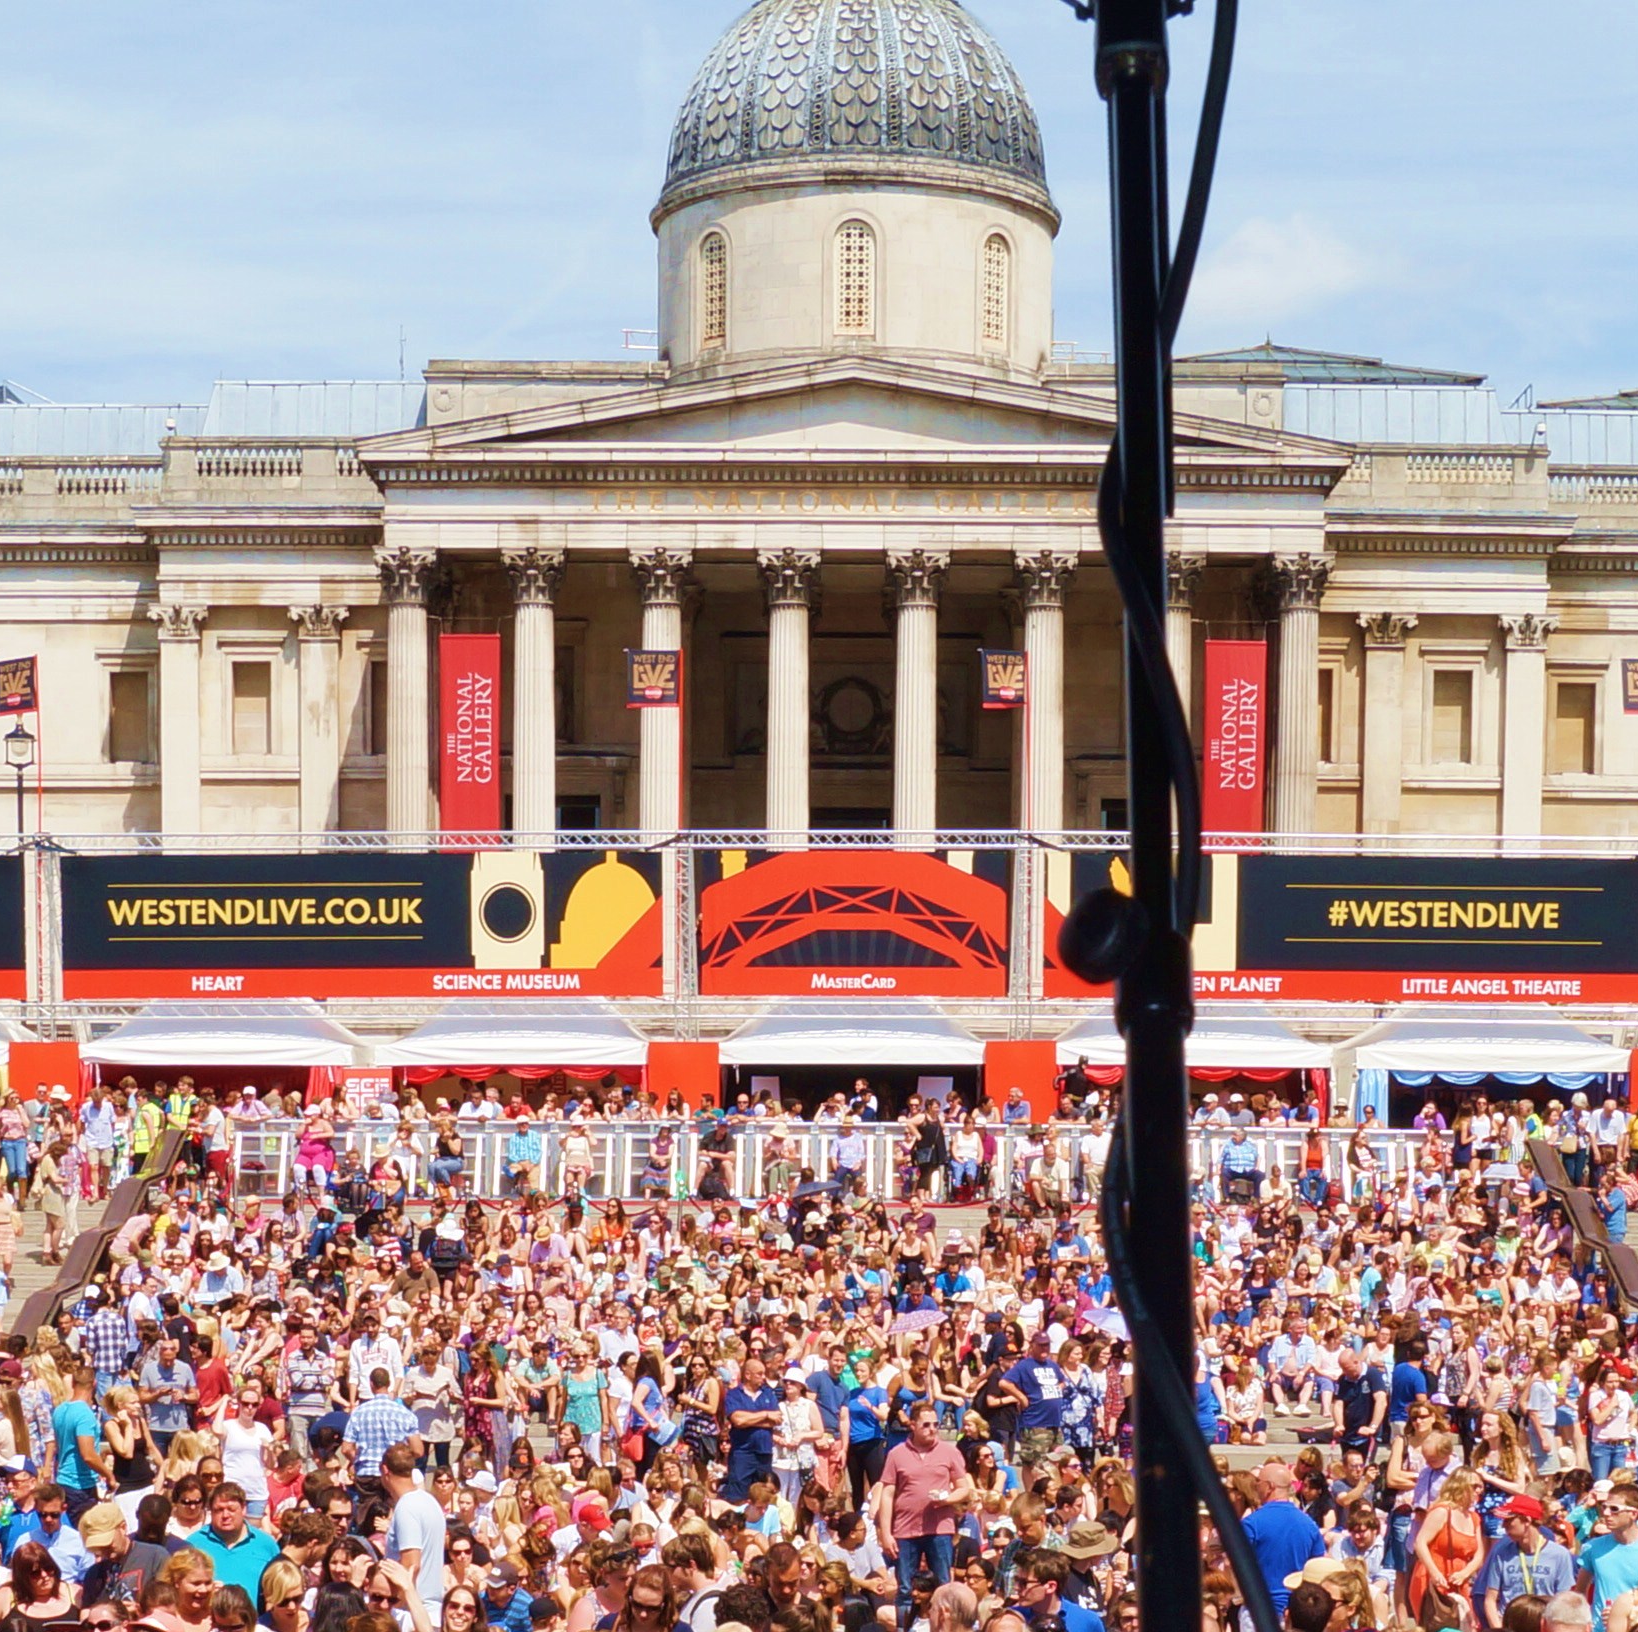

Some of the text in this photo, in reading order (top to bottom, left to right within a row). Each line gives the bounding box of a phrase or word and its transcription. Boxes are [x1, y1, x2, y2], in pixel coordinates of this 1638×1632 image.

[588, 491, 1097, 516] THE NATIONAL GALLER
[0, 670, 30, 698] LIVE
[633, 664, 675, 688] LIVE
[987, 664, 1024, 688] LIVE
[457, 672, 473, 782] NATIONAL
[474, 672, 492, 783] GALLERY
[1220, 678, 1238, 789] NATIONAL
[1238, 679, 1258, 790] GALLERY
[108, 898, 423, 925] WESTENDLIVE.CO.UK
[1328, 901, 1559, 929] #WESTENDLIVE
[191, 976, 244, 991] HEART
[433, 975, 580, 990] SCIENCE MUSEUM
[1220, 977, 1282, 992] PLANET
[1402, 979, 1581, 996] LITTLE ANGEL THEATRE
